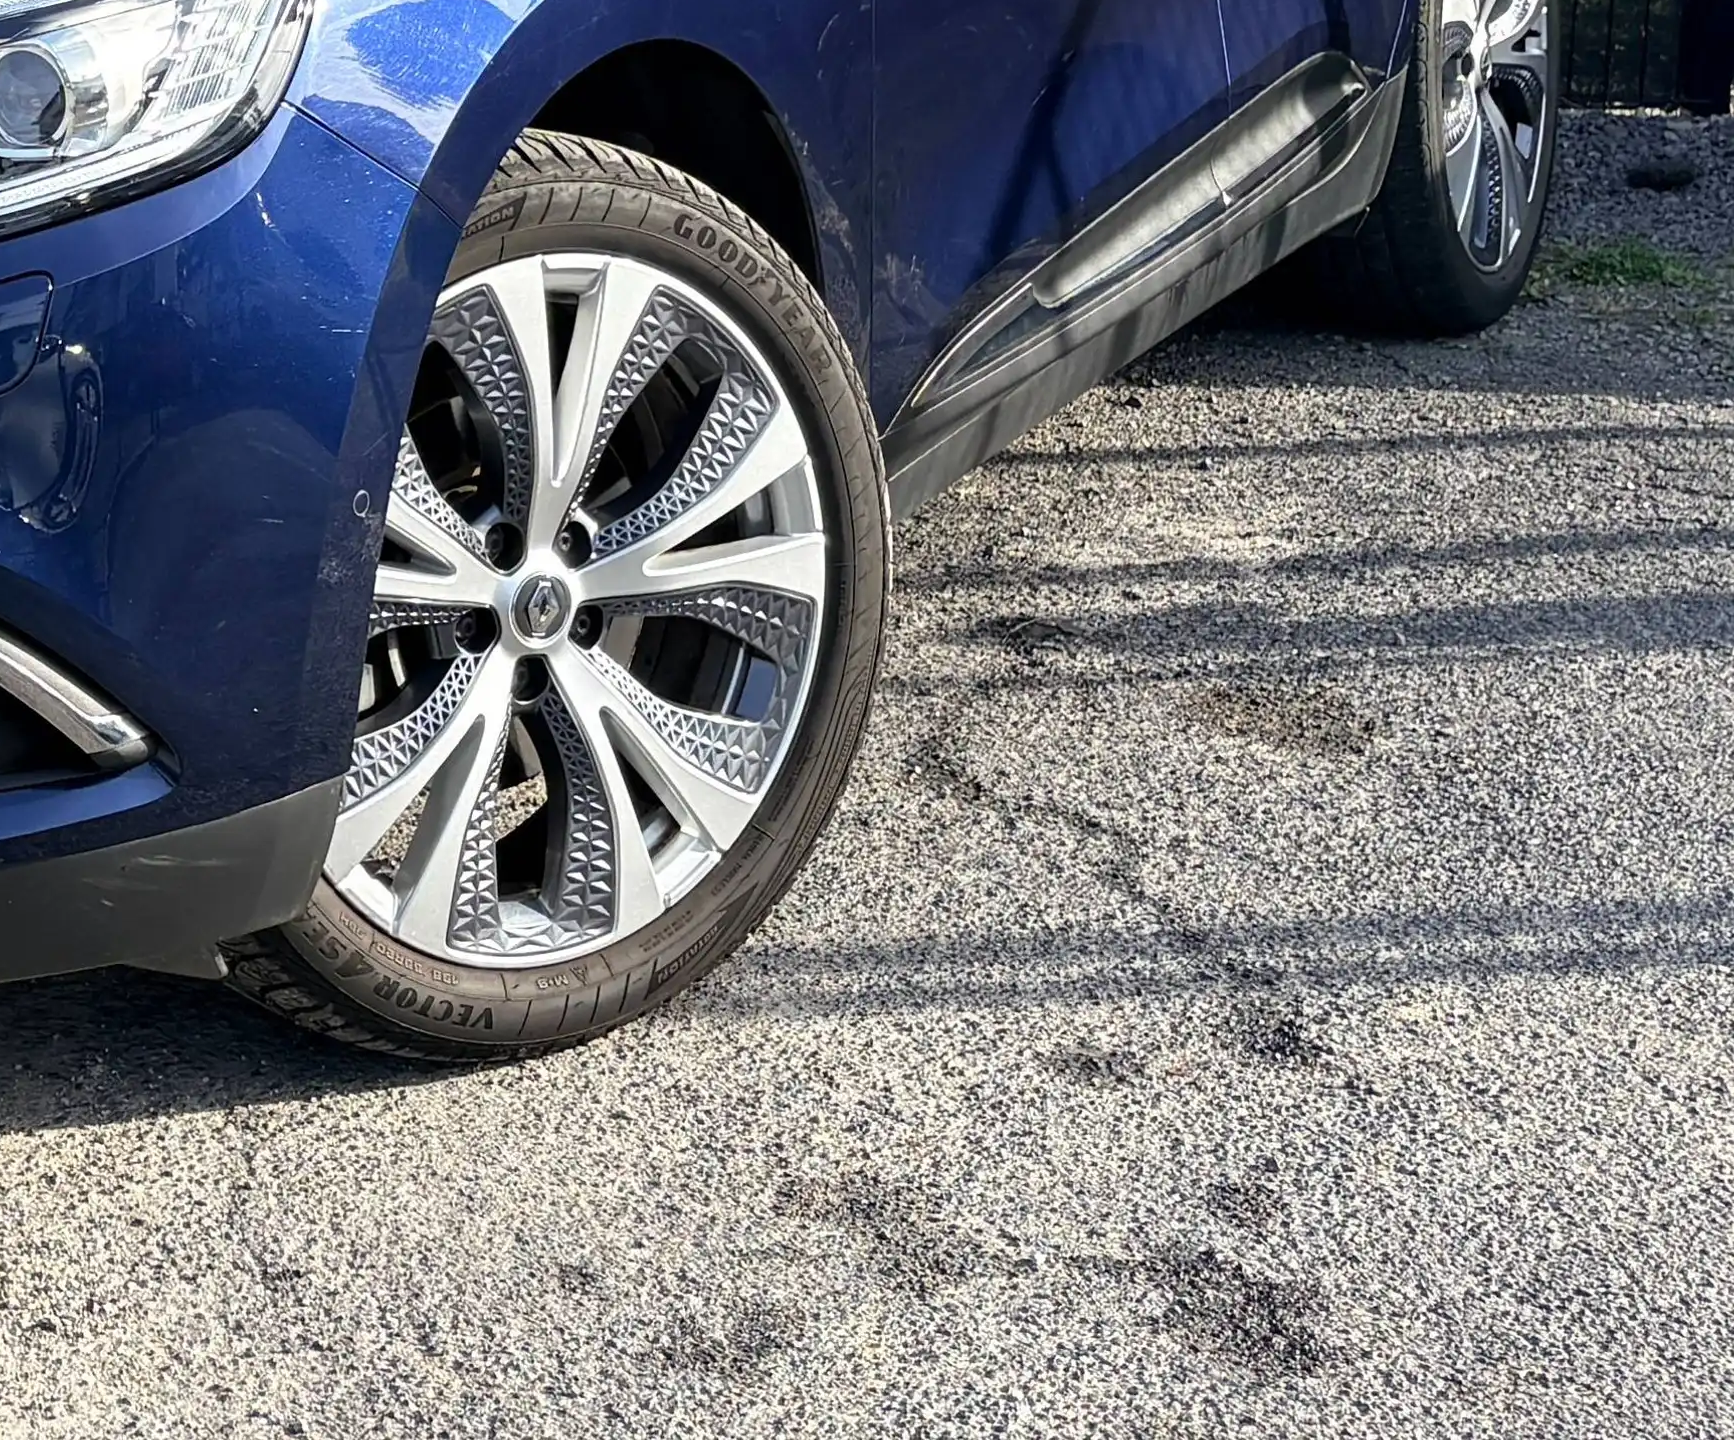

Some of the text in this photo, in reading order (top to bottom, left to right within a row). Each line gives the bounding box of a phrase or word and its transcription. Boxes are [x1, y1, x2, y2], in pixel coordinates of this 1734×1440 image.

[467, 206, 515, 237] ATION
[673, 213, 833, 373] GOODYEAR
[373, 975, 494, 1030] VECTOR
